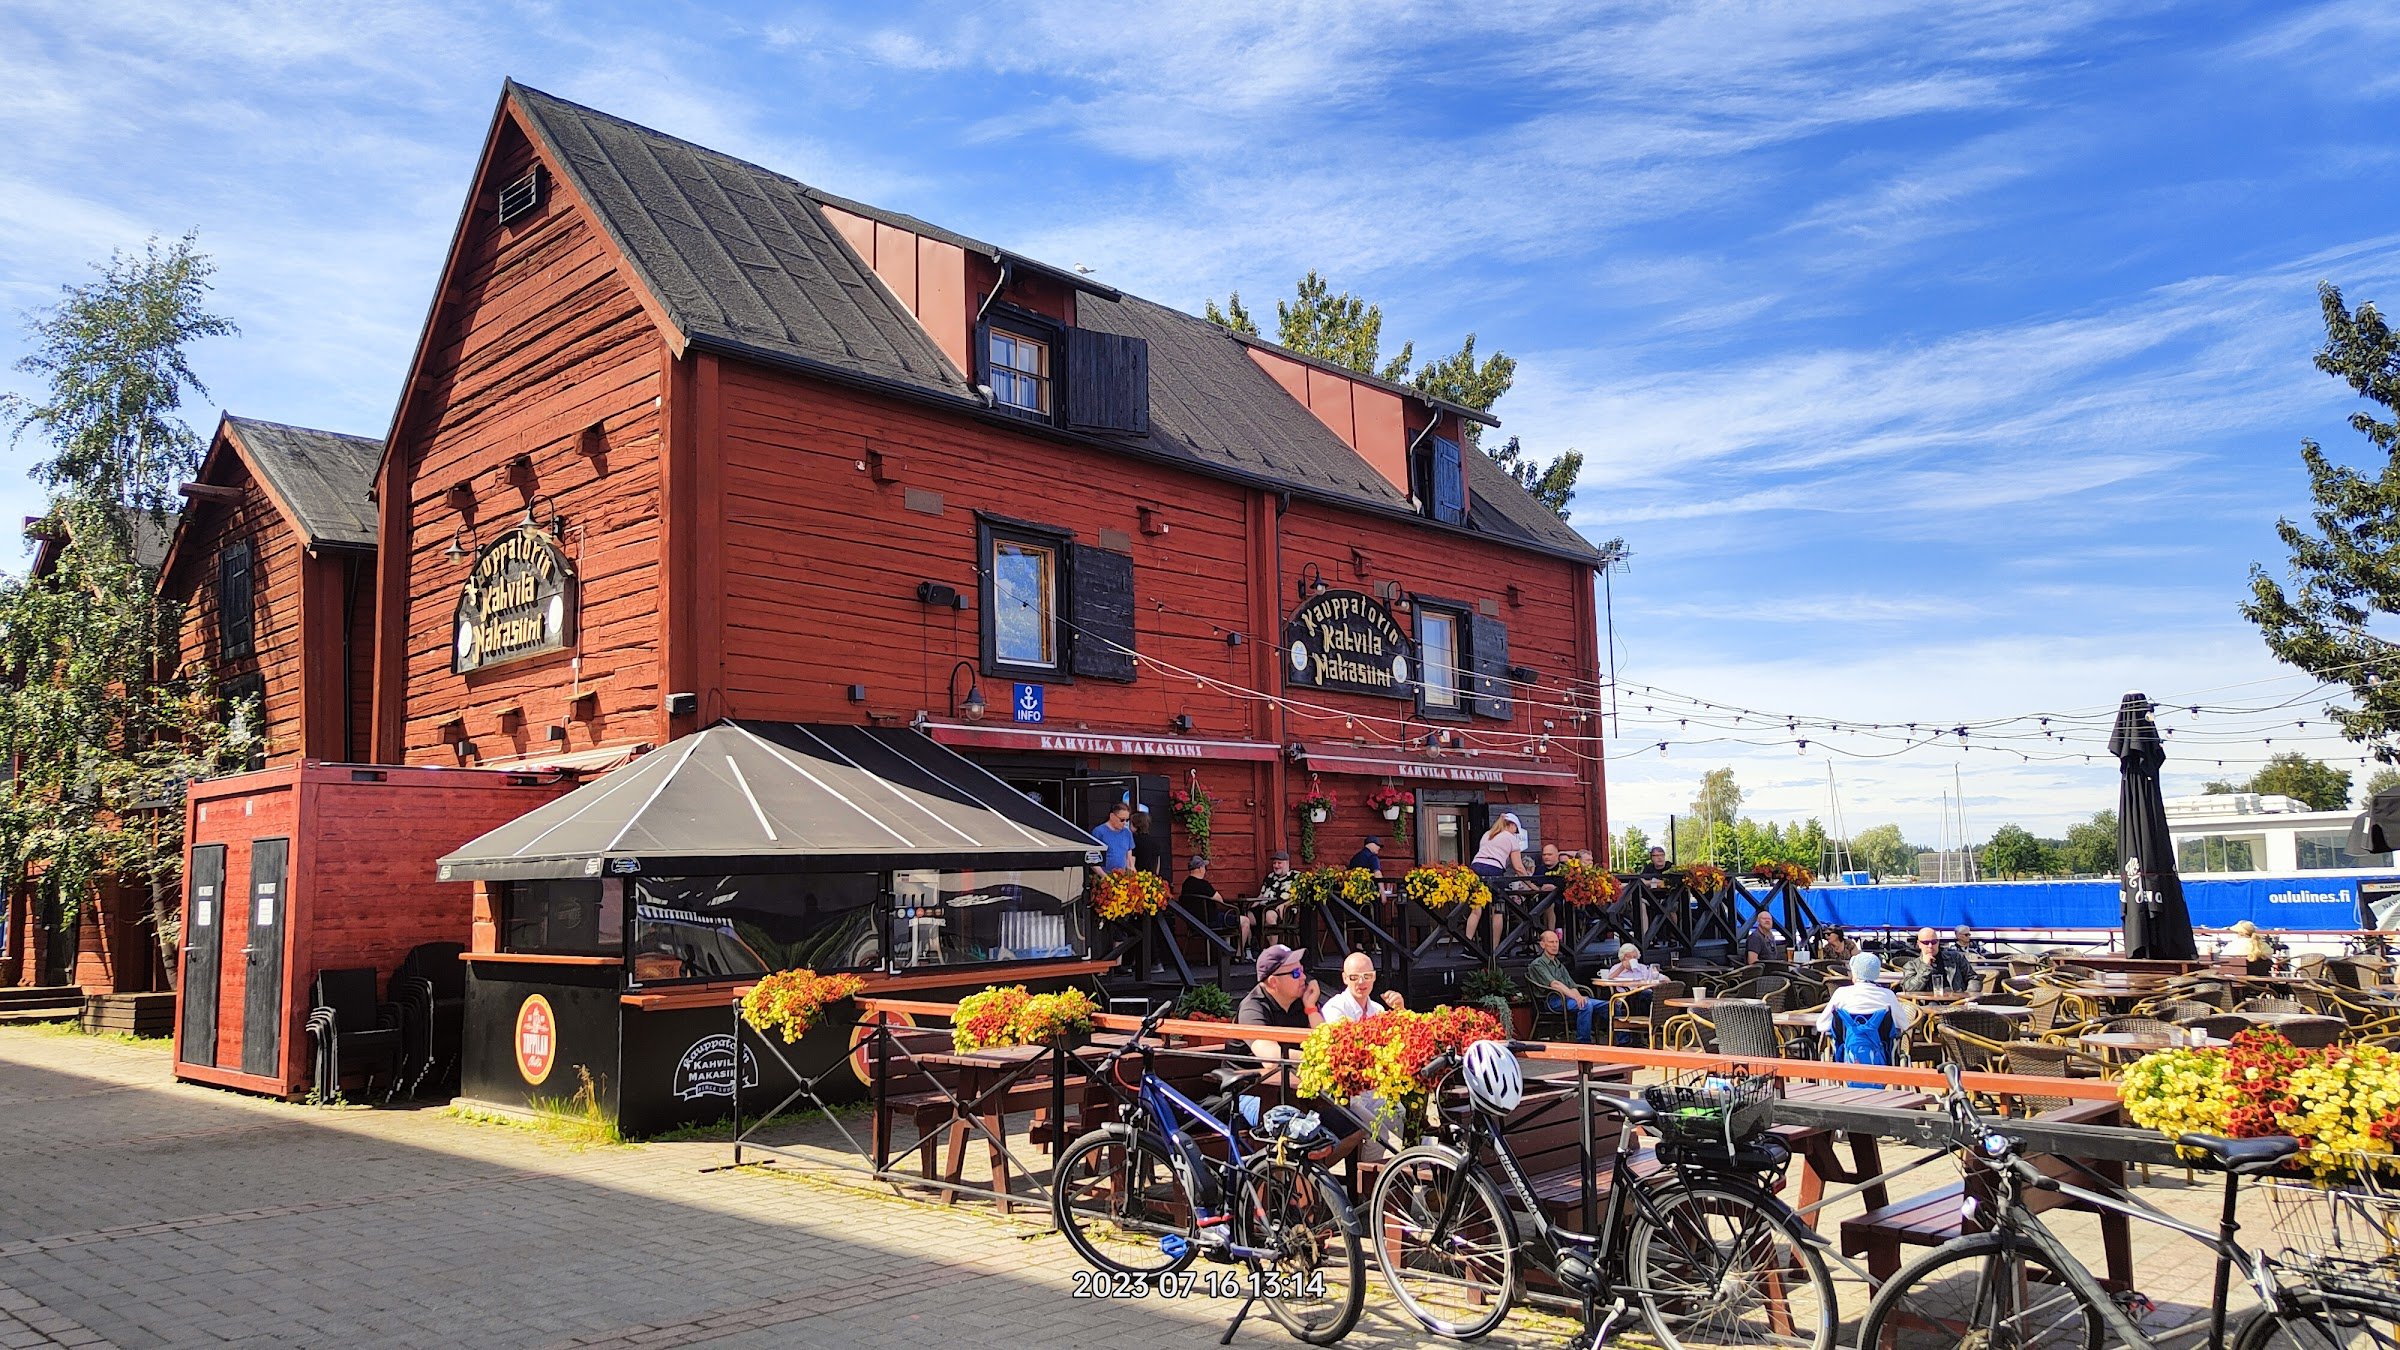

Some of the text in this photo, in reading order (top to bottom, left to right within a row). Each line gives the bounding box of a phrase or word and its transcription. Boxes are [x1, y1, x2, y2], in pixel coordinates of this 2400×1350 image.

[480, 570, 535, 622] Kahvila
[1301, 595, 1400, 646] Kauppatorin
[471, 612, 542, 664] Makasiini
[1320, 622, 1383, 657] Kahvila
[1312, 652, 1392, 688] Makasiini
[1016, 709, 1041, 722] INFO
[1040, 736, 1203, 757] KAHVILA MAKASIINI
[1398, 765, 1504, 782] KAHVILA MAKASIINI
[2268, 889, 2351, 904] oululines.fi
[682, 1038, 750, 1071] Kauppaton
[693, 1058, 736, 1071] KAHVIL
